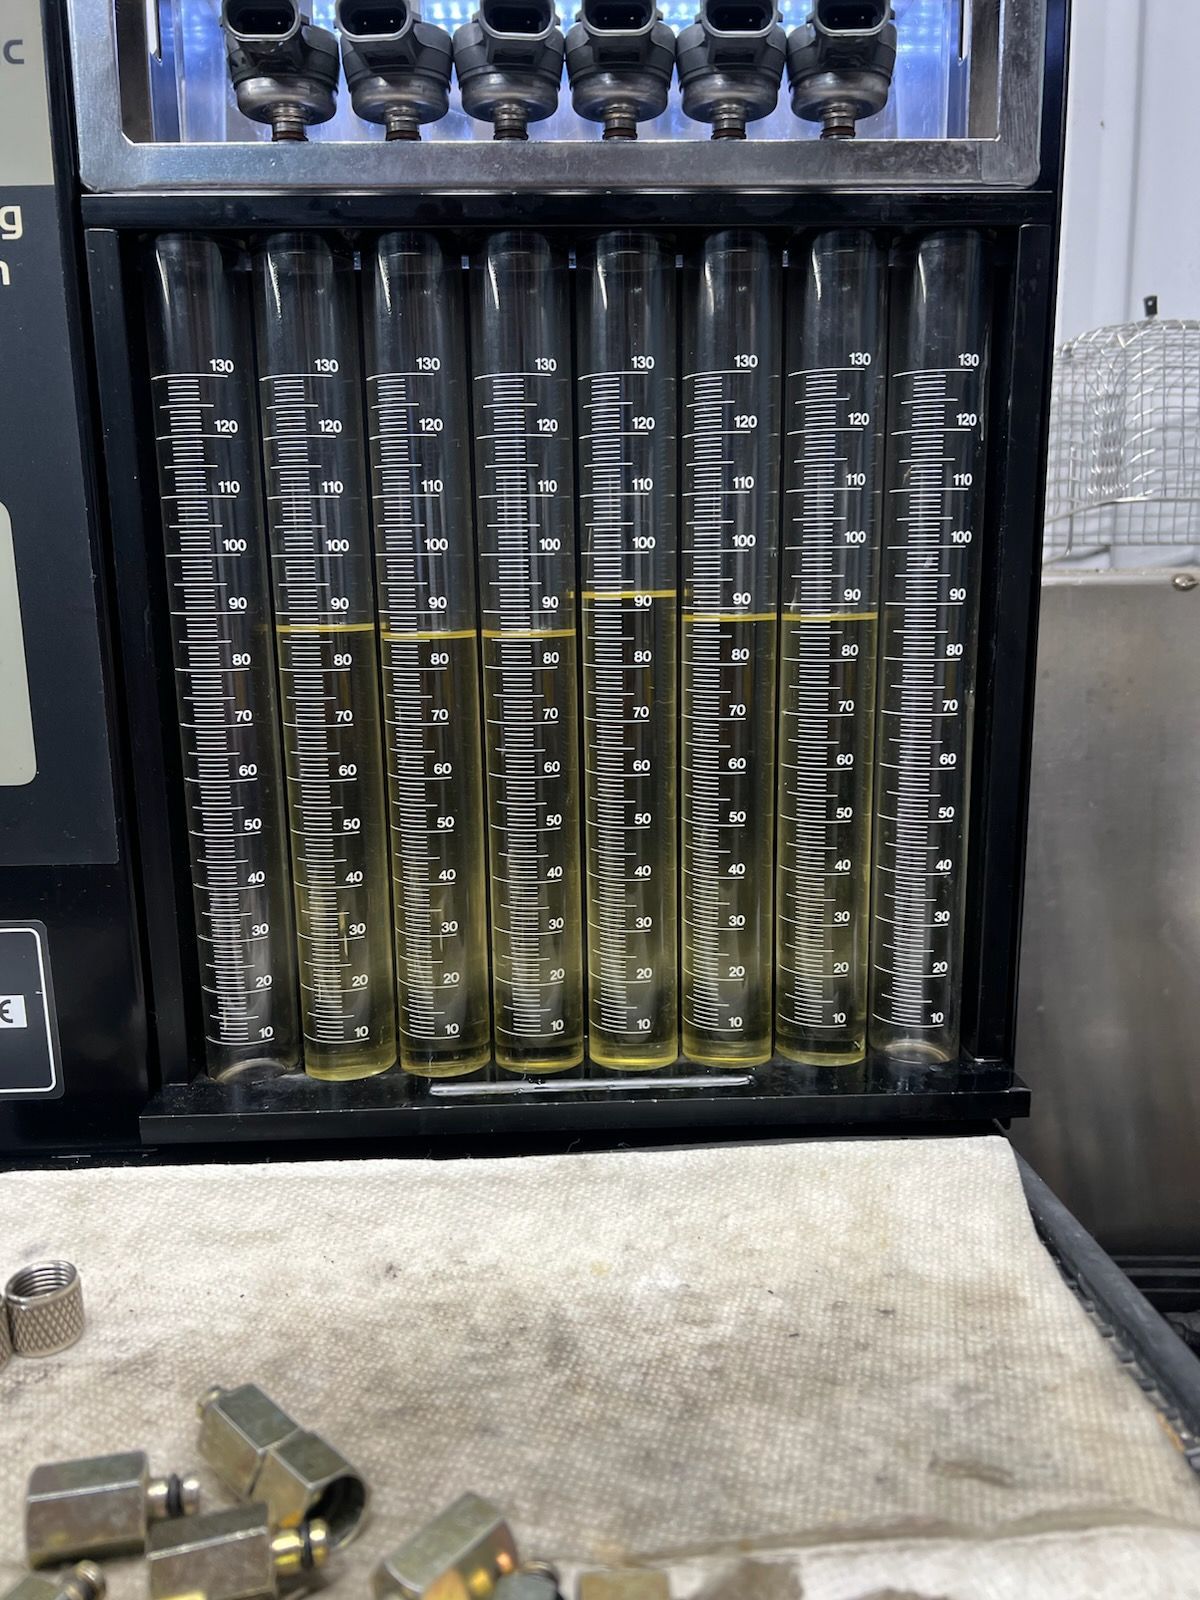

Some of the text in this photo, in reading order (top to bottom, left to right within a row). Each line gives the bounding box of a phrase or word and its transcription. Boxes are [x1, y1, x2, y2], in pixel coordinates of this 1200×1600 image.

[209, 358, 234, 373] 130
[314, 358, 339, 373] 130
[416, 357, 441, 371] 130
[534, 357, 557, 372] 130
[631, 355, 655, 370] 130
[733, 354, 759, 368] 130
[848, 352, 872, 366] 130
[958, 353, 980, 367] 130
[418, 417, 443, 432] 120
[536, 418, 558, 432] 120
[631, 416, 656, 430] 120
[733, 414, 758, 429] 120
[847, 412, 870, 426] 120
[956, 412, 977, 427] 120
[214, 419, 238, 434] 120
[318, 419, 343, 433] 120
[421, 479, 444, 493] 110
[537, 479, 558, 493] 110
[631, 477, 654, 491] 110
[732, 476, 755, 489] 110
[845, 473, 866, 486] 110
[952, 473, 973, 486] 110
[217, 480, 240, 494] 110
[321, 480, 344, 494] 110
[632, 536, 656, 549] 100
[732, 534, 756, 547] 100
[844, 530, 867, 544] 100
[950, 530, 972, 544] 100
[222, 538, 247, 552] 100
[325, 539, 350, 552] 100
[424, 538, 449, 551] 100
[539, 538, 561, 551] 100
[633, 594, 653, 607] 90
[732, 592, 752, 605] 90
[843, 588, 861, 601] 90
[949, 588, 966, 601] 90
[228, 597, 248, 610] 90
[330, 597, 350, 610] 90
[428, 596, 448, 609] 90
[541, 595, 559, 609] 90
[731, 648, 750, 661] 80
[841, 644, 859, 657] 80
[946, 643, 963, 656] 80
[232, 653, 251, 666] 80
[333, 653, 353, 667] 80
[430, 652, 449, 665] 80
[542, 651, 560, 664] 80
[633, 650, 652, 663] 80
[632, 705, 650, 719] 70
[728, 703, 746, 717] 70
[838, 699, 855, 713] 70
[942, 699, 959, 712] 70
[234, 709, 253, 723] 70
[335, 709, 353, 723] 70
[431, 708, 449, 721] 70
[542, 707, 559, 720] 70
[728, 757, 747, 770] 60
[836, 753, 854, 766] 60
[939, 752, 957, 765] 60
[238, 763, 258, 777] 60
[338, 763, 357, 777] 60
[433, 762, 452, 775] 60
[543, 760, 561, 773] 60
[633, 759, 651, 772] 60
[634, 812, 652, 825] 50
[728, 810, 747, 823] 50
[835, 806, 853, 819] 50
[938, 806, 955, 819] 50
[244, 817, 262, 831] 50
[342, 817, 361, 831] 50
[436, 816, 455, 829] 50
[546, 813, 562, 827] 50
[634, 864, 652, 877] 40
[727, 863, 746, 875] 40
[834, 859, 851, 871] 40
[935, 858, 952, 871] 40
[247, 871, 265, 884] 40
[345, 870, 363, 884] 40
[438, 868, 457, 881] 40
[546, 865, 563, 879] 40
[635, 916, 653, 929] 30
[728, 914, 746, 927] 30
[833, 910, 850, 923] 30
[934, 910, 951, 923] 30
[251, 923, 269, 937] 30
[349, 922, 367, 936] 30
[441, 920, 459, 933] 30
[548, 917, 564, 930] 30
[636, 967, 653, 980] 20
[728, 965, 745, 977] 20
[833, 961, 849, 974] 20
[932, 961, 948, 974] 20
[255, 974, 272, 988] 20
[351, 973, 369, 987] 20
[443, 971, 460, 984] 20
[549, 968, 565, 981] 20
[636, 1018, 651, 1030] 10
[728, 1016, 743, 1028] 10
[832, 1012, 846, 1024] 10
[930, 1011, 944, 1024] 10
[354, 1025, 369, 1038] 10
[444, 1023, 459, 1035] 10
[550, 1019, 564, 1032] 10
[258, 1026, 274, 1039] 10
